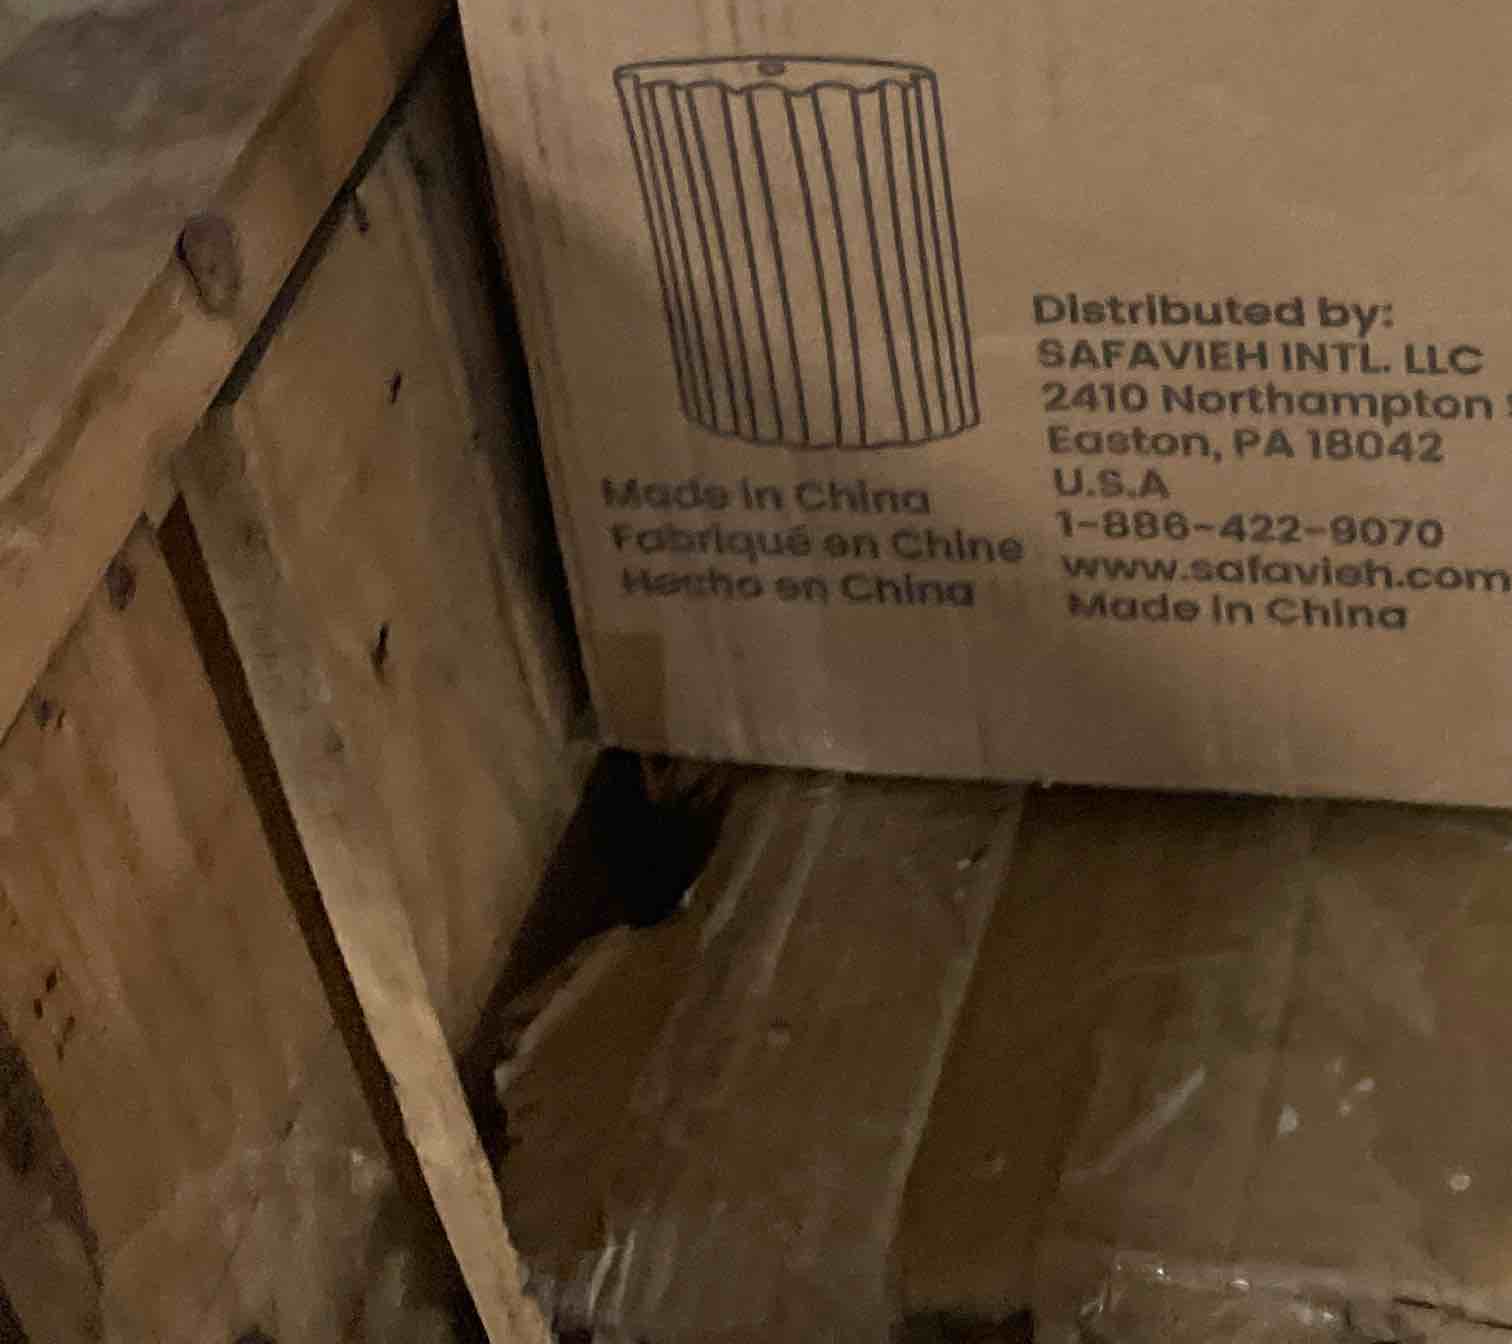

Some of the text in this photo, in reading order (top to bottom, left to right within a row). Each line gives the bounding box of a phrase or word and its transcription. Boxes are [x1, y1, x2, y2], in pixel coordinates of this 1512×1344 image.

[1033, 293, 1394, 337] Distributed by:
[1036, 338, 1268, 371] SAFAVIEH
[1405, 344, 1484, 376] LLC
[1041, 382, 1148, 413] 2410
[1161, 384, 1493, 426] Northampton
[1048, 424, 1444, 463] Easton, PA 18042
[601, 477, 728, 511] Made
[795, 479, 930, 514] China
[822, 535, 880, 560] en
[892, 528, 1025, 563] Chine
[774, 578, 828, 605] en
[840, 572, 976, 608] China
[1062, 553, 1512, 593] www.safavieh.com
[1067, 593, 1198, 621] Made
[1267, 596, 1408, 630] China
